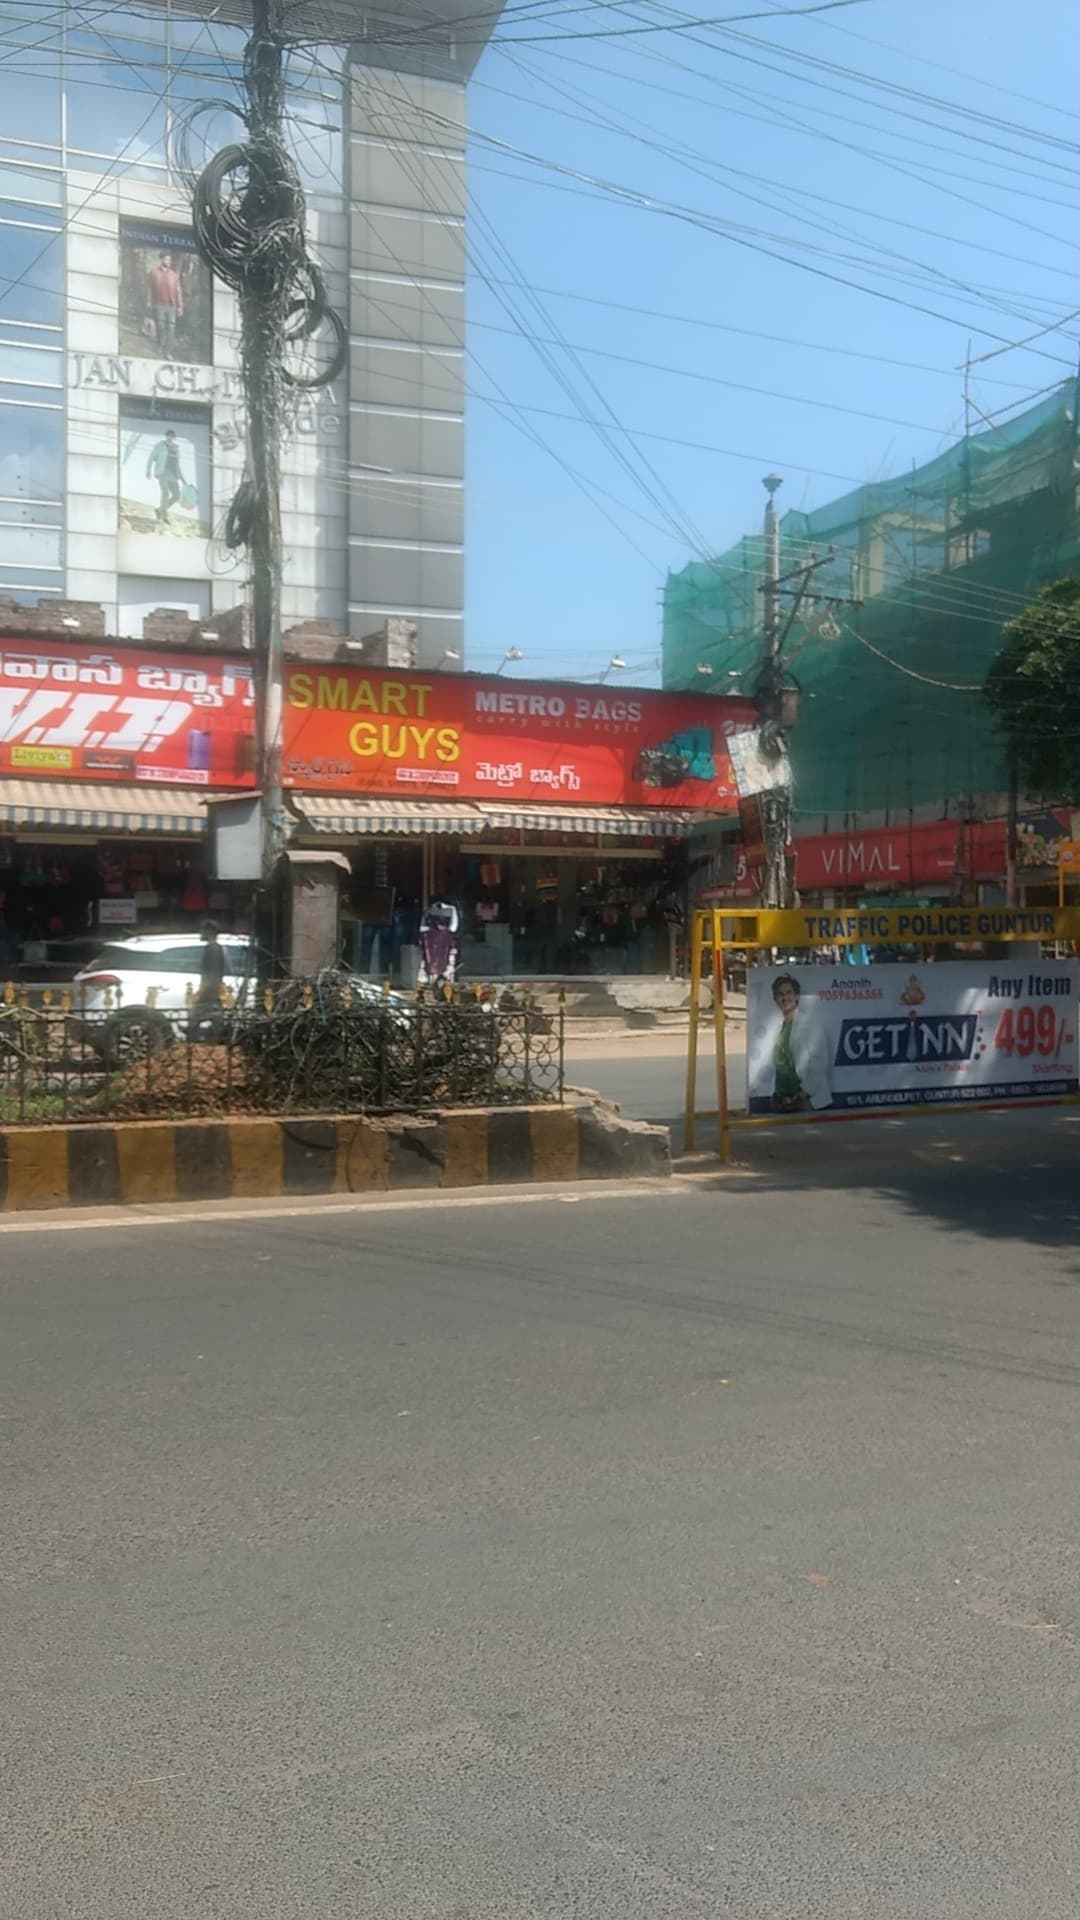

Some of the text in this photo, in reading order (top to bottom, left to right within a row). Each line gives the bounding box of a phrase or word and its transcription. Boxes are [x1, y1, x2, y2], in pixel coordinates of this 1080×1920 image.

[73, 354, 132, 389] JAN
[0, 653, 123, 686] వాస్
[288, 673, 433, 717] SMART
[475, 691, 643, 722] METRO BAGS
[475, 714, 640, 735] carry with style
[349, 722, 460, 762] GUYS
[475, 762, 523, 787] మెట్రో
[821, 841, 901, 873] VIMAL
[804, 914, 1056, 939] TRAFFIC POLICE GUNTUR
[831, 978, 872, 989] Ananth
[987, 974, 1072, 999] Any Item
[994, 1004, 1074, 1058] 499/-
